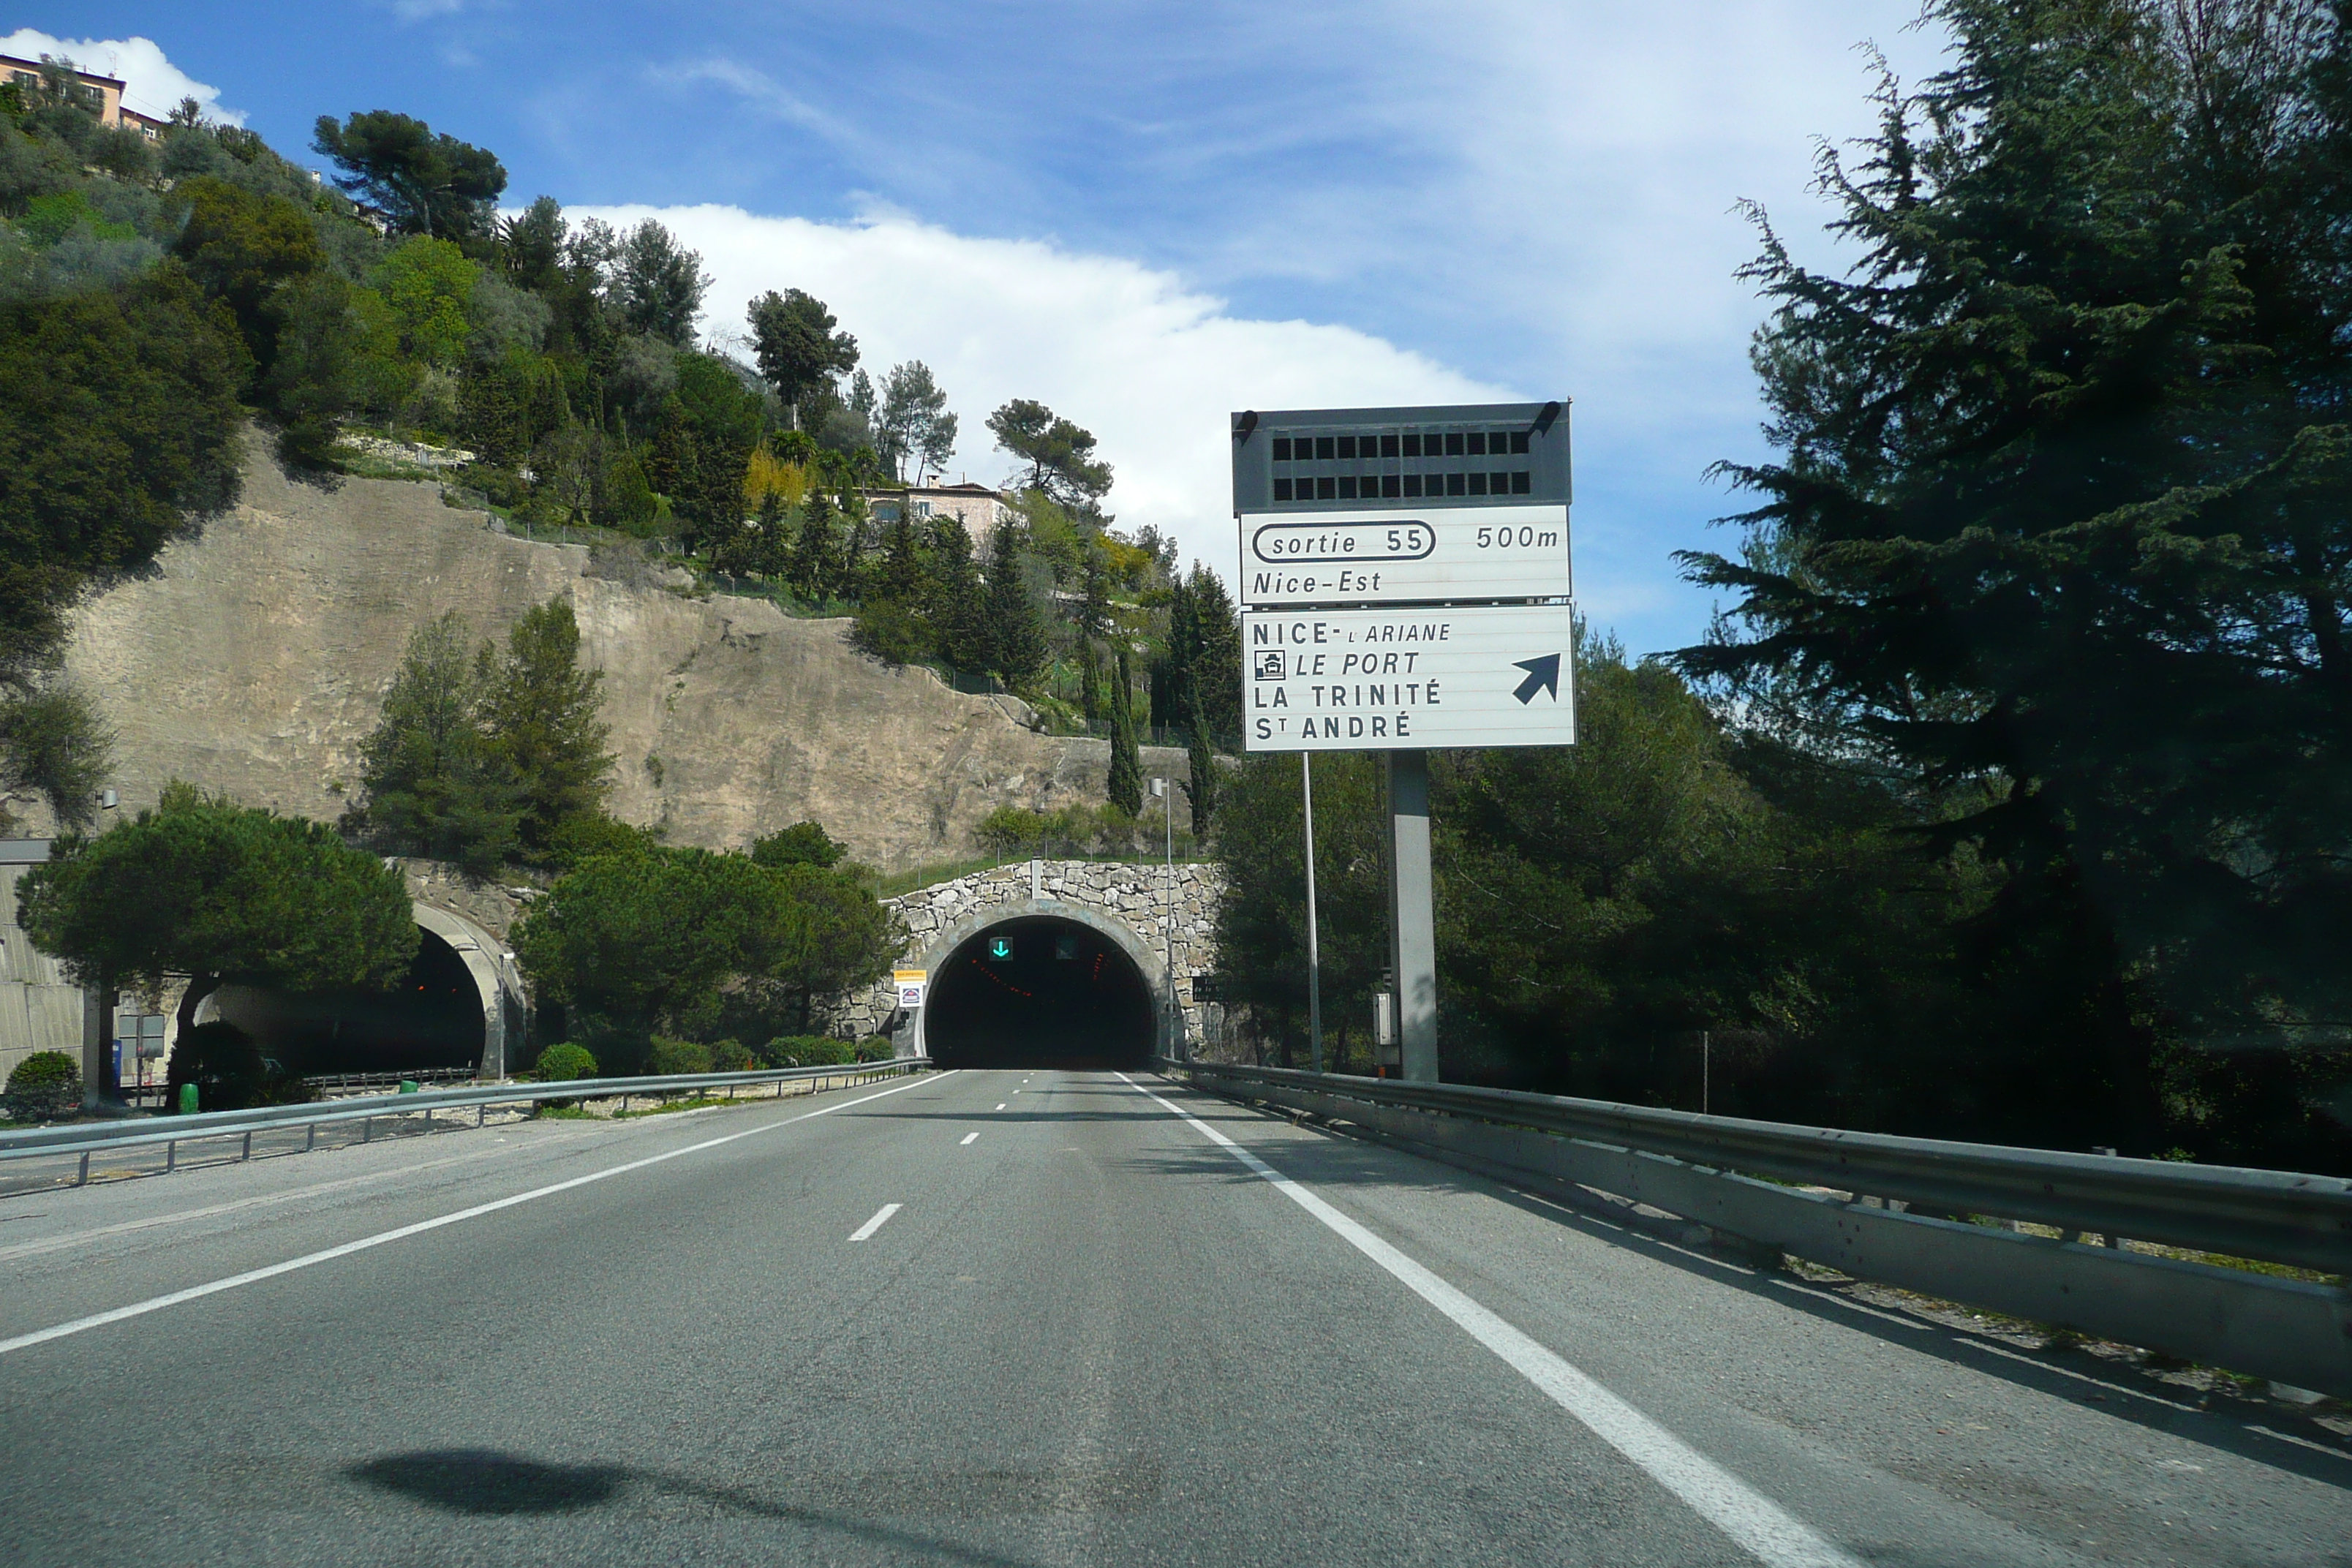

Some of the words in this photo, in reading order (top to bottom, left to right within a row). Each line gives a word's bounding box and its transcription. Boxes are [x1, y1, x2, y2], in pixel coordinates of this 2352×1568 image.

[1272, 531, 1356, 554] sortie
[1387, 529, 1422, 551] 55
[1477, 526, 1558, 549] 500m
[1254, 570, 1382, 595] Nice-Est
[1296, 654, 1326, 676] LE
[1342, 652, 1419, 675] PORT
[1254, 687, 1289, 708] LA
[1311, 679, 1441, 707] TRINITÉ
[1302, 711, 1410, 739] ANDRÉ
